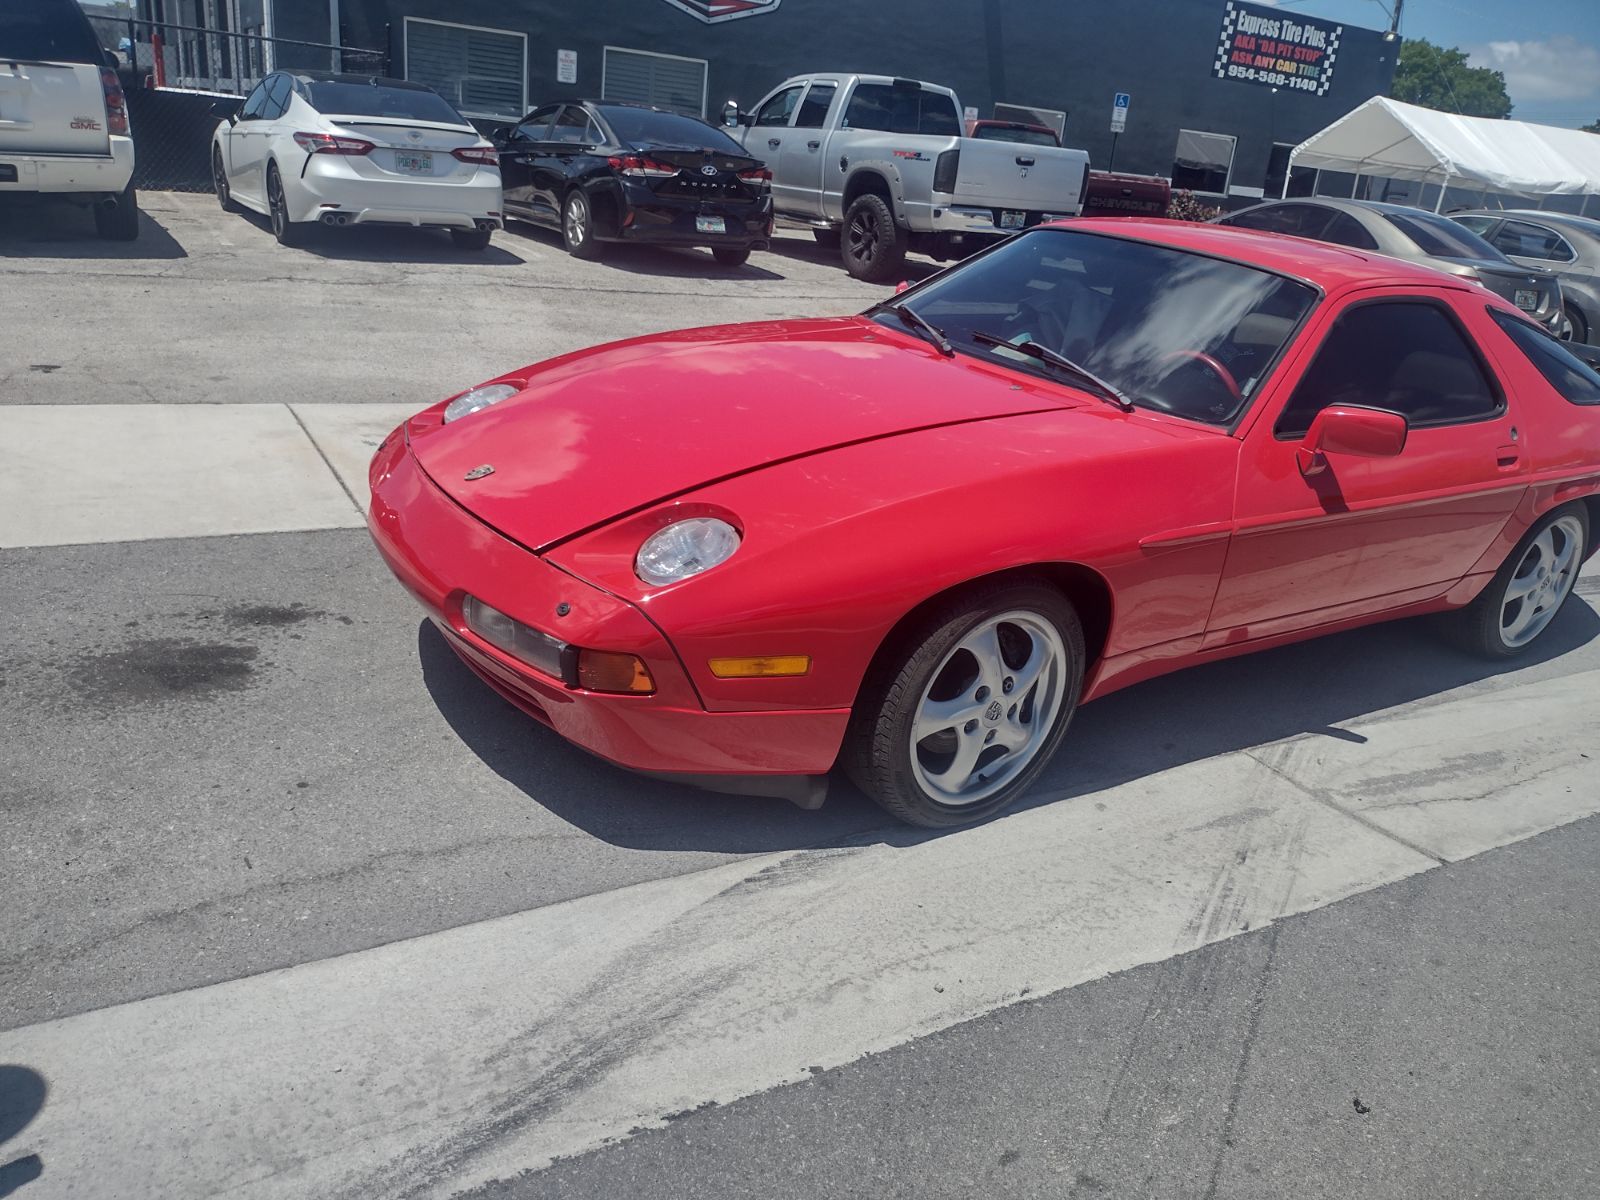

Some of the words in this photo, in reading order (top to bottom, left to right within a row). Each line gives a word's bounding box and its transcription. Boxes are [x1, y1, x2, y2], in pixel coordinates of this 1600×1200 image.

[1237, 10, 1280, 39] Express
[1281, 20, 1302, 43] Tire
[1302, 24, 1327, 50] Plus,
[1234, 34, 1256, 50] AKA
[1258, 39, 1276, 55] "DA
[1276, 43, 1295, 58] PIT
[1293, 47, 1324, 63] STOP"
[1227, 64, 1318, 92] 954-588-1140
[1230, 50, 1255, 64] ASK
[1254, 55, 1276, 70] ANY
[1275, 59, 1298, 74] CAR
[1298, 63, 1321, 78] TIRE
[71, 122, 101, 130] GMC
[680, 181, 737, 190] SONATA
[1089, 197, 1161, 211] CHEVROLET
